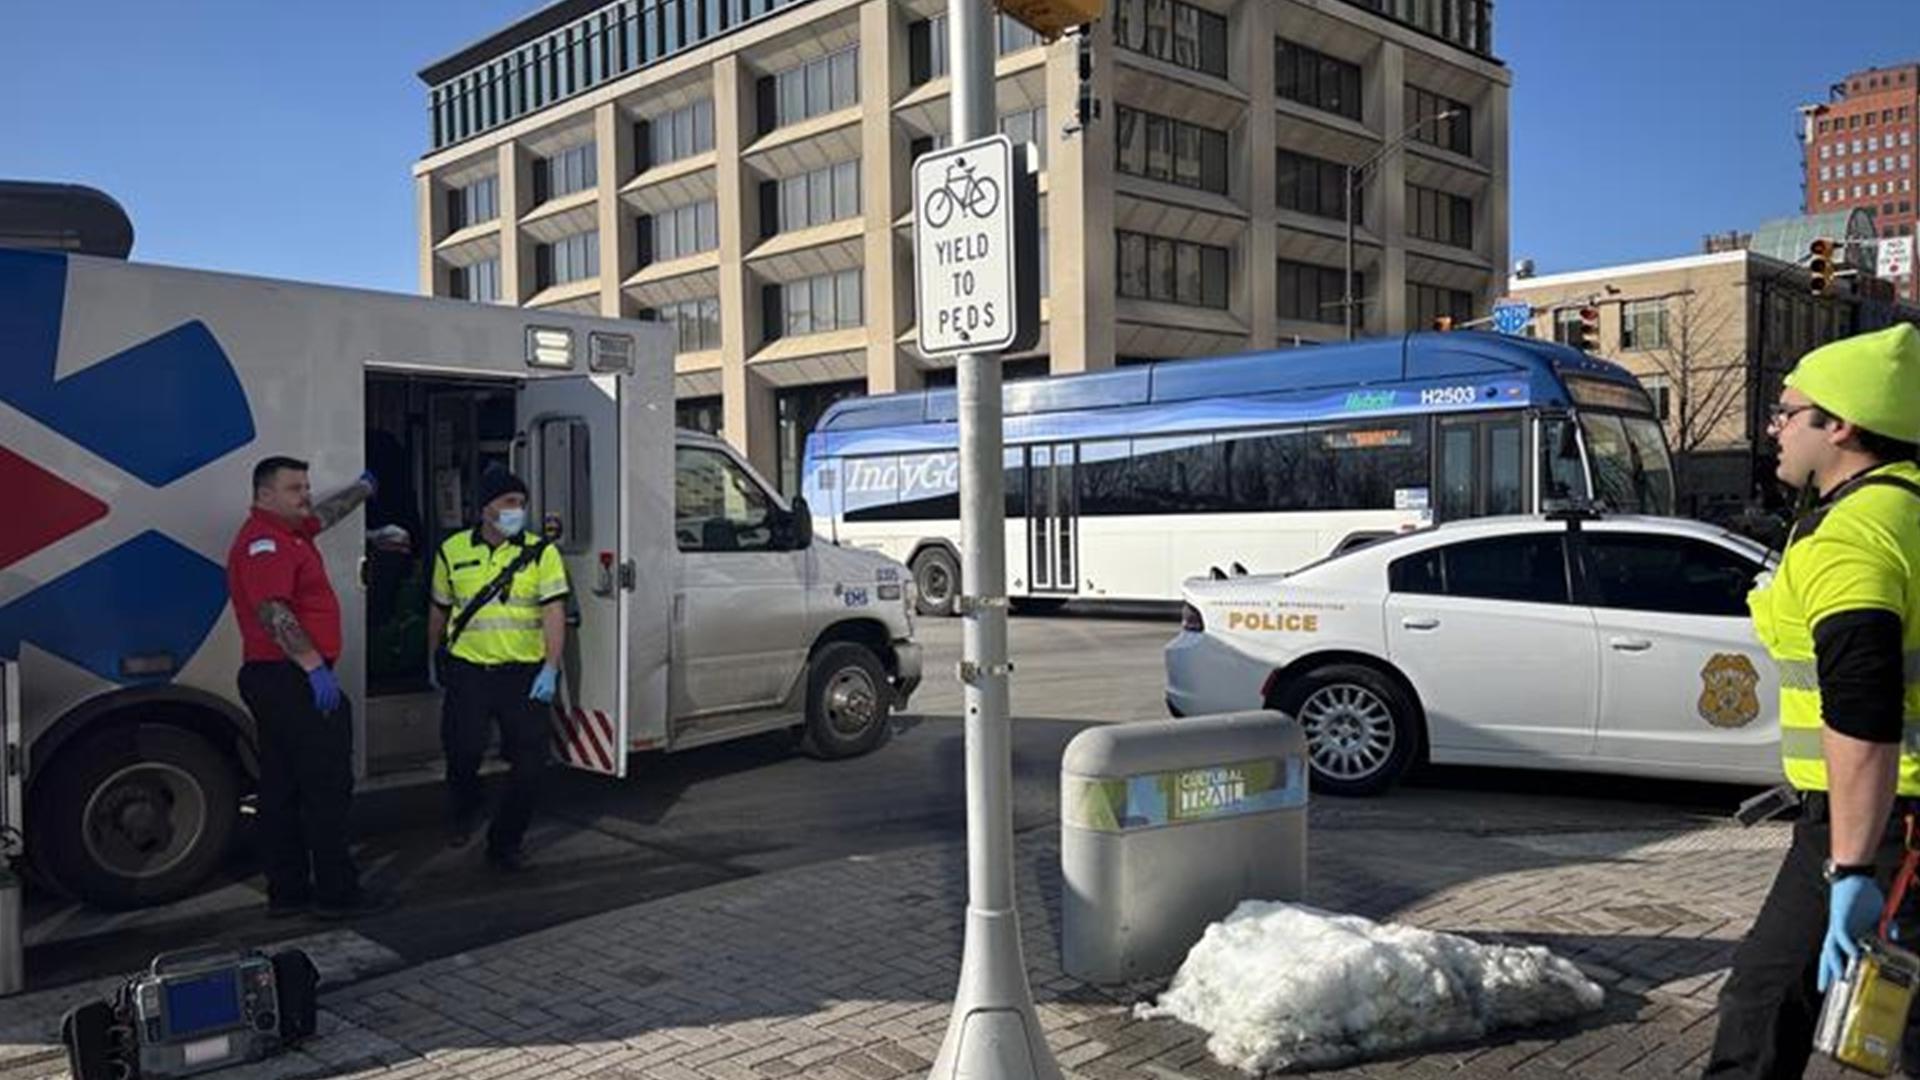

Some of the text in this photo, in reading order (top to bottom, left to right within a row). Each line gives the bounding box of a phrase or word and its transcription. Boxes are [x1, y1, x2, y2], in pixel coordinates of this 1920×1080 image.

[936, 233, 988, 266] YIELD
[952, 270, 975, 297] TO
[939, 302, 995, 334] PEDS
[1420, 386, 1476, 405] H2503
[1229, 611, 1318, 633] POLICE
[1181, 768, 1245, 790] CULTURAL
[1181, 781, 1245, 811] TRAIL
